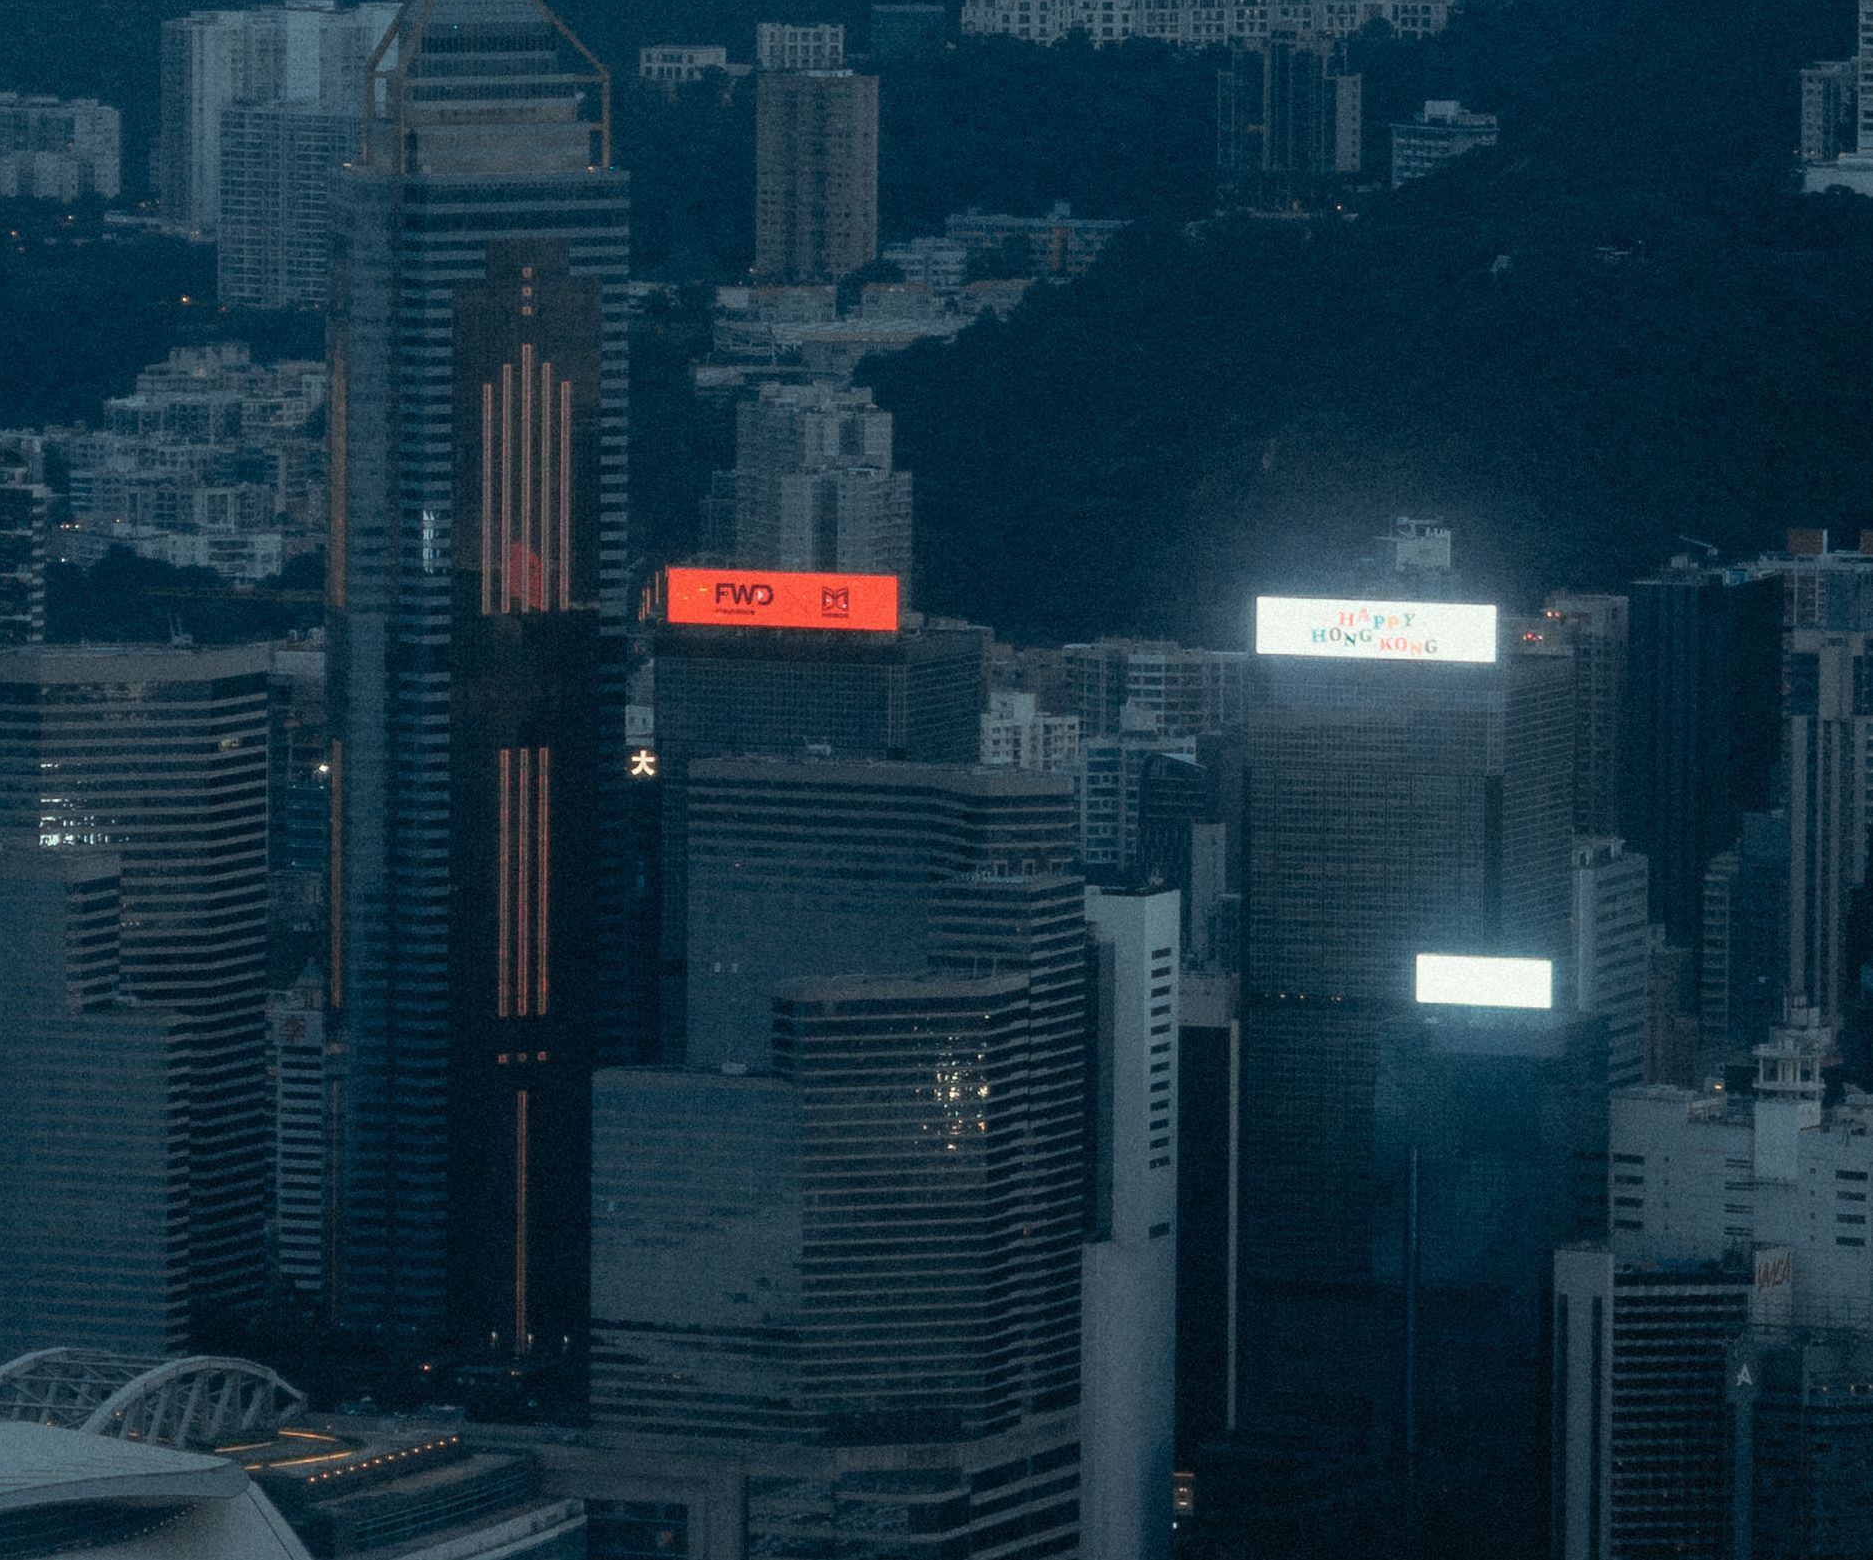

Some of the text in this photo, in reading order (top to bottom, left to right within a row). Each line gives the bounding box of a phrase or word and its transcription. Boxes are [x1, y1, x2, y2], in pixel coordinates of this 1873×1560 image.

[715, 583, 774, 606] FWD
[1338, 607, 1416, 631] HAPPY
[1311, 627, 1439, 655] HONG KONG
